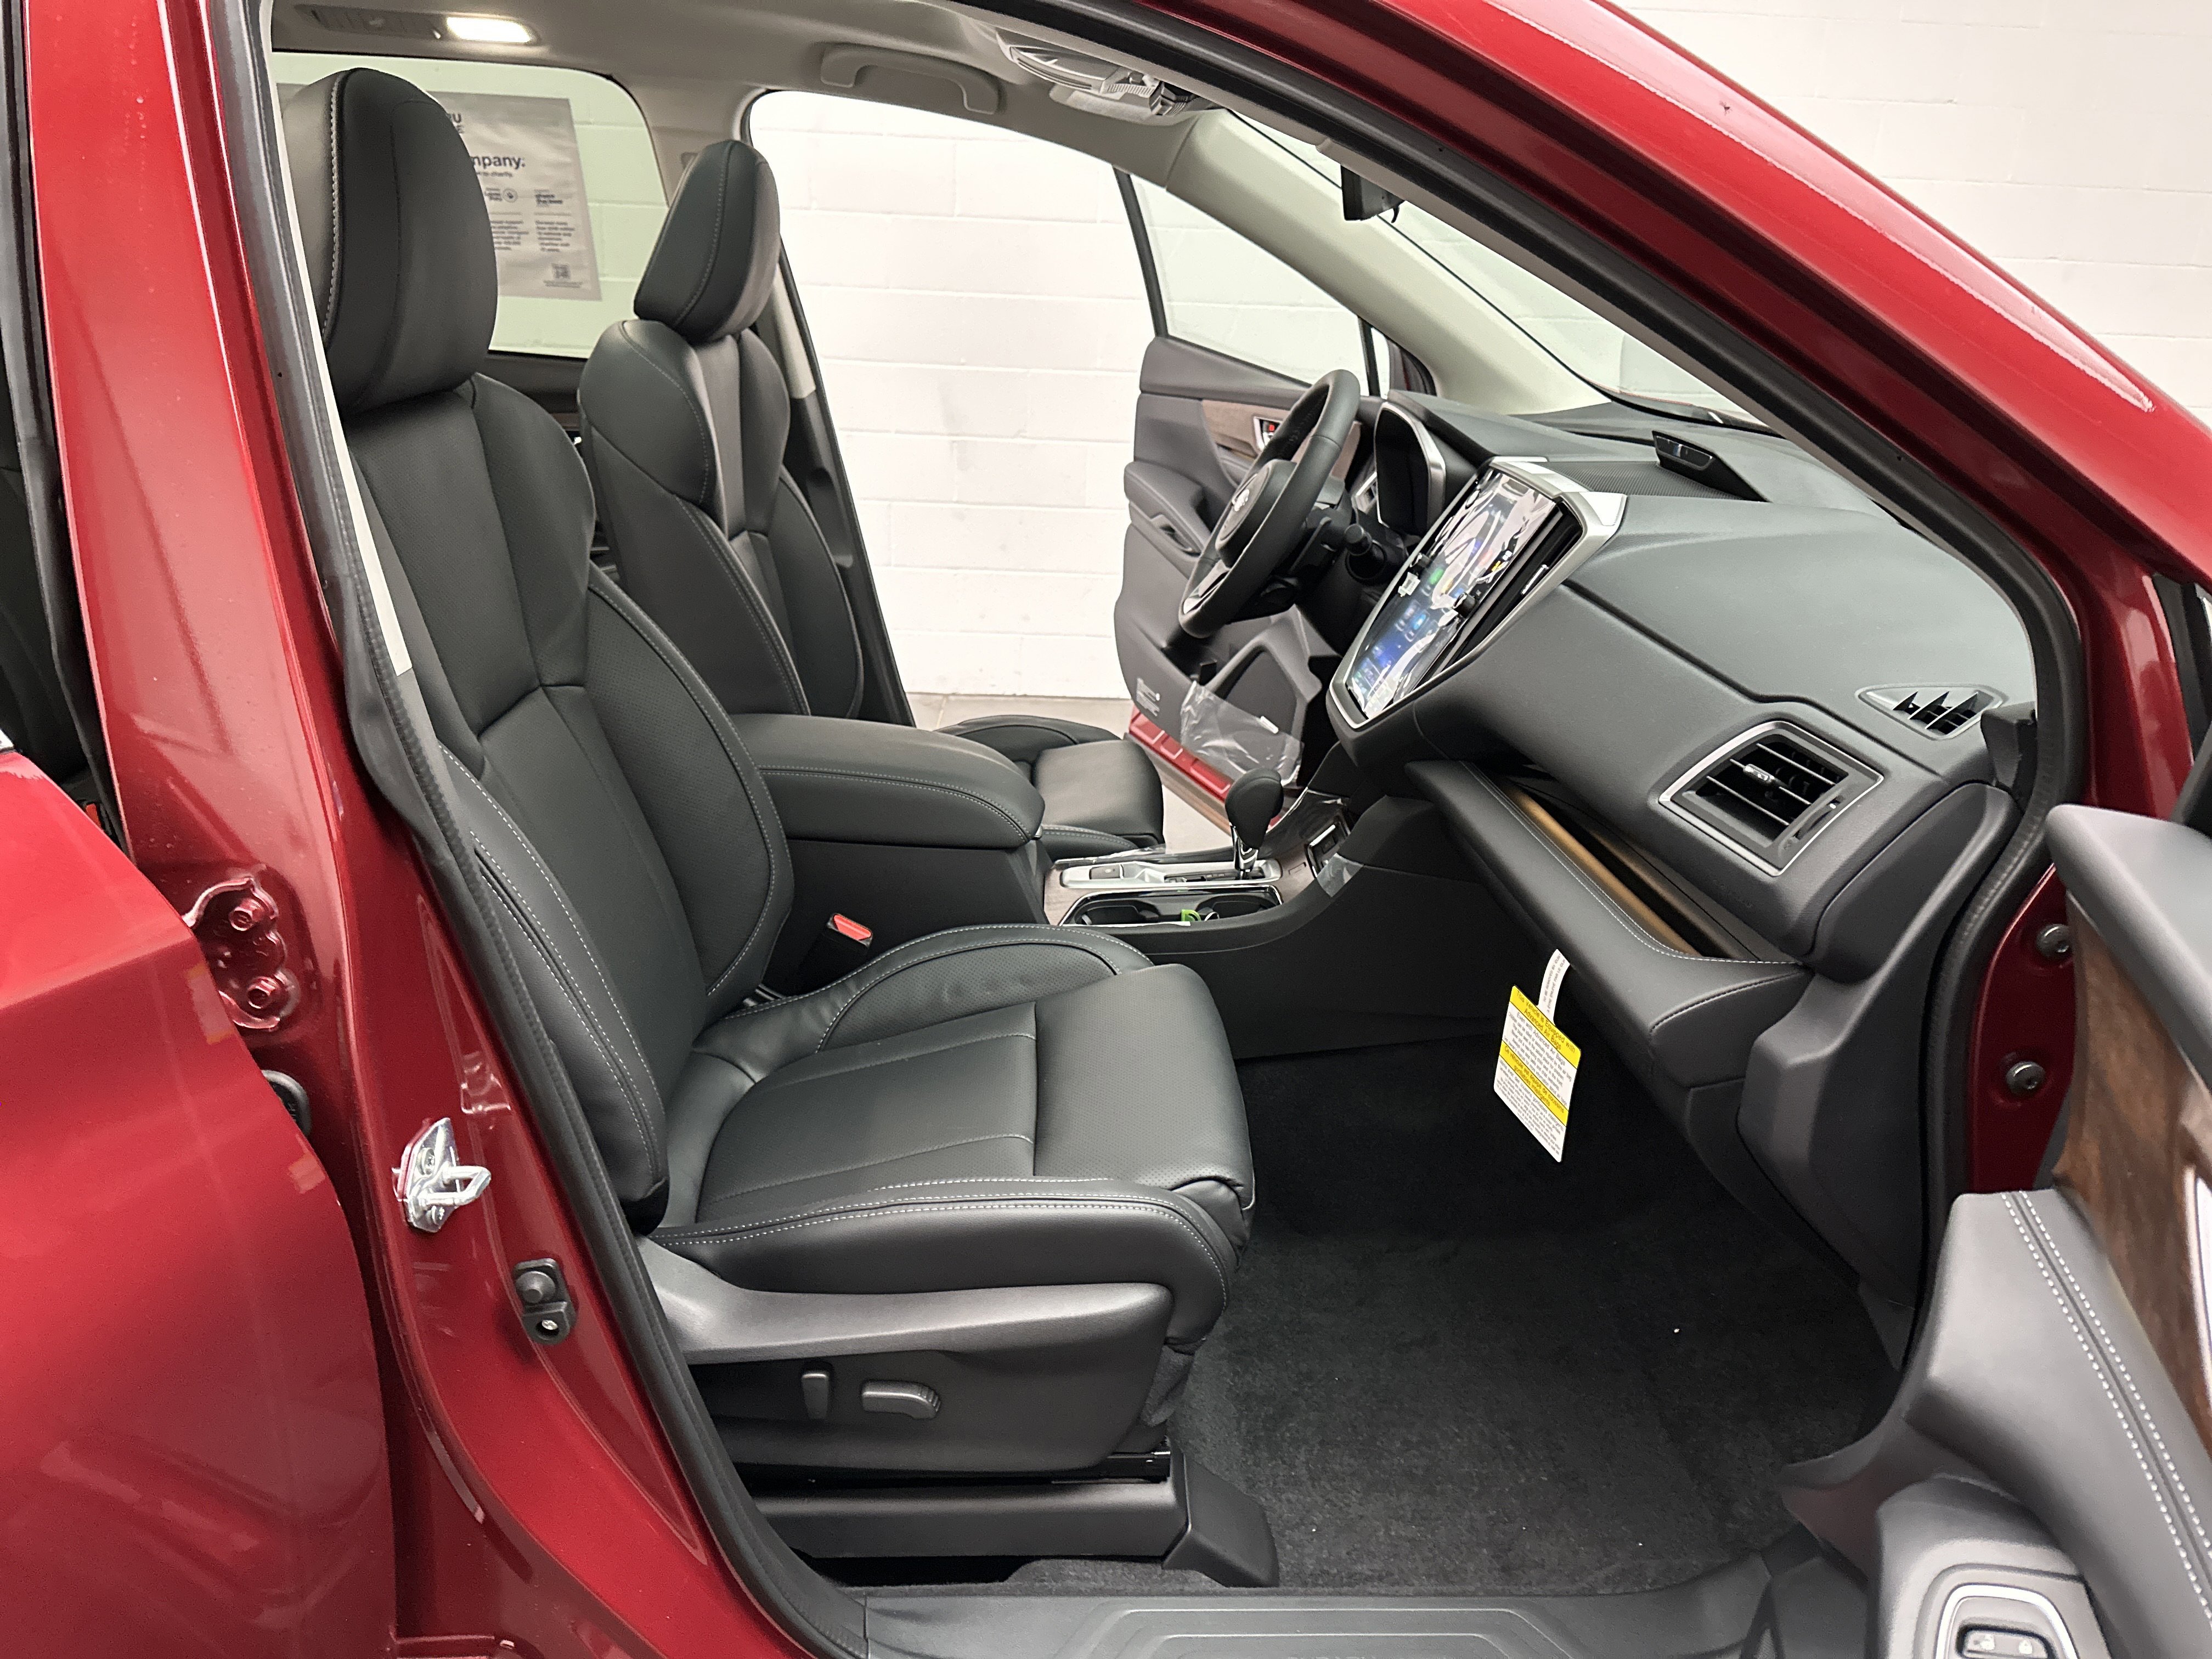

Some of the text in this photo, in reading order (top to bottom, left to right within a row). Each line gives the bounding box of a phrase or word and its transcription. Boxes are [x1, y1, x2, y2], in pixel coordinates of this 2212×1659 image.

[1516, 989, 1576, 1054] This Vehicle is Equipped with
[1516, 1011, 1525, 1025] Even
[1533, 1028, 1550, 1049] Advanced
[1555, 1052, 1566, 1068] Bags
[1523, 1006, 1543, 1031] Advanced
[1550, 1033, 1562, 1052] Bags
